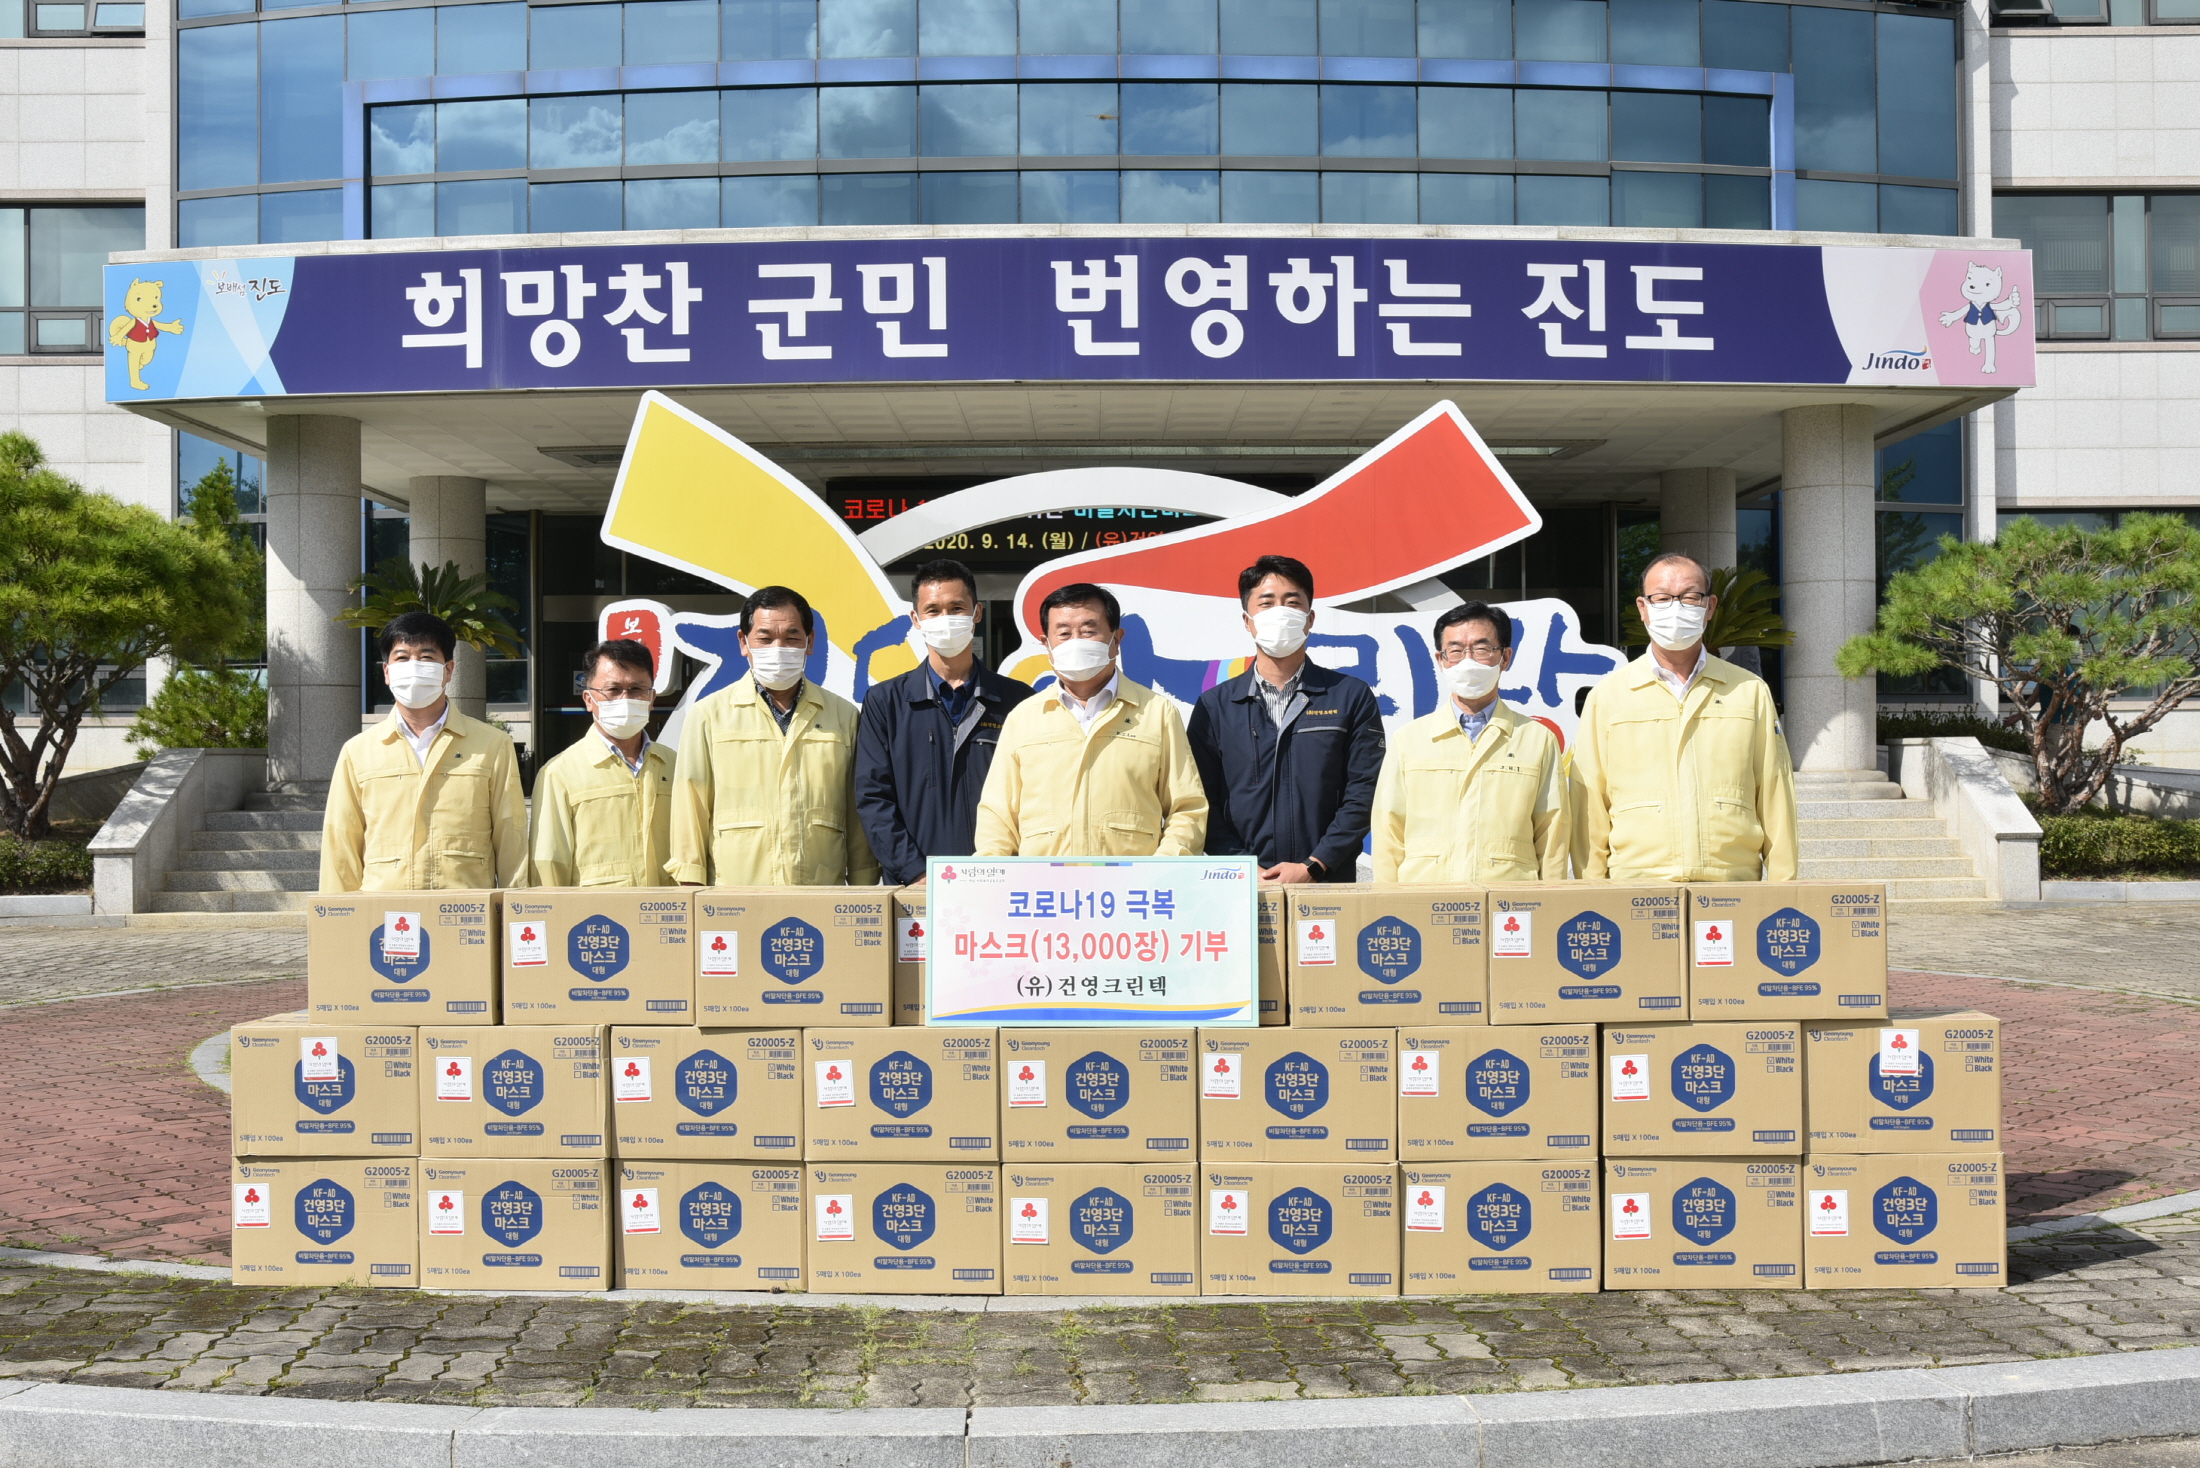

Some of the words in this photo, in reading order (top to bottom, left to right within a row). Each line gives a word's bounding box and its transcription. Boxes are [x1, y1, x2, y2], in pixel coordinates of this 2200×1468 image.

[216, 282, 246, 296] 보배섬
[248, 277, 286, 301] 진도
[402, 261, 702, 368] 희망찬
[747, 256, 949, 361] 군민
[1050, 254, 1472, 359] 번영하는
[1521, 259, 1715, 359] 진도
[1862, 352, 1920, 370] Jindo
[982, 533, 999, 549] 9.
[1006, 533, 1034, 549] 14.
[1042, 531, 1074, 549] (월)
[1200, 868, 1238, 881] Jindo
[1008, 889, 1116, 920] 코로나19
[1126, 889, 1176, 920] 극복
[1631, 896, 1680, 907] G20005-Z
[1831, 894, 1879, 904] G20005-Z
[440, 903, 485, 913] G20005-Z
[640, 902, 687, 911] G20005-Z
[834, 904, 882, 913] G20005-Z
[1432, 902, 1481, 912] G20005-Z
[587, 924, 610, 933] KF-AD
[1577, 921, 1601, 930] KF-AD
[1776, 918, 1800, 927] KF-AD
[780, 927, 804, 936] KF-AD
[1377, 926, 1401, 935] KF-AD
[1766, 929, 1811, 944] 건영3단
[577, 936, 620, 950] 건영3단
[771, 938, 814, 952] 건영3단
[1367, 937, 1411, 952] 건영3단
[1567, 932, 1611, 947] 건영3단
[955, 930, 1169, 963] 마스크(13,000장)
[1181, 930, 1229, 962] 기부
[1771, 945, 1808, 959] 마스크
[581, 951, 617, 964] 마스크
[775, 954, 811, 967] 마스크
[1371, 953, 1408, 967] 마스크
[1571, 948, 1608, 962] 마스크
[1782, 960, 1796, 969] 대형
[365, 1036, 411, 1045] G20005-Z
[553, 1036, 601, 1046] G20005-Z
[1540, 1035, 1589, 1045] G20005-Z
[1746, 1030, 1794, 1040] G20005-Z
[1945, 1030, 1994, 1039] G20005-Z
[748, 1038, 795, 1047] G20005-Z
[943, 1038, 991, 1047] G20005-Z
[1140, 1039, 1188, 1048] G20005-Z
[1340, 1039, 1388, 1049] G20005-Z
[501, 1059, 524, 1069] KF-AD
[695, 1060, 718, 1069] KF-AD
[1485, 1059, 1510, 1068] KF-AD
[1691, 1054, 1715, 1063] KF-AD
[889, 1061, 913, 1070] KF-AD
[1085, 1062, 1109, 1071] KF-AD
[1285, 1062, 1309, 1071] KF-AD
[1681, 1065, 1725, 1079] 건영3단
[492, 1071, 534, 1085] 건영3단
[685, 1071, 728, 1085] 건영3단
[879, 1072, 923, 1086] 건영3단
[1075, 1073, 1120, 1087] 건영3단
[1275, 1074, 1319, 1087] 건영3단
[1475, 1071, 1520, 1085] 건영3단
[308, 1084, 343, 1097] 마스크
[496, 1086, 531, 1099] 마스크
[689, 1086, 725, 1099] 마스크
[1685, 1081, 1722, 1095] 마스크
[1884, 1079, 1921, 1093] 마스크
[883, 1088, 920, 1101] 마스크
[1080, 1088, 1116, 1102] 마스크
[1279, 1089, 1316, 1102] 마스크
[1480, 1086, 1517, 1100] 마스크
[1091, 1104, 1105, 1112] 대형
[365, 1167, 410, 1176] G20005-Z
[552, 1168, 599, 1177] G20005-Z
[752, 1170, 799, 1179] G20005-Z
[1542, 1169, 1590, 1179] G20005-Z
[1747, 1164, 1795, 1174] G20005-Z
[1948, 1163, 1997, 1173] G20005-Z
[946, 1170, 994, 1180] G20005-Z
[1144, 1174, 1192, 1184] G20005-Z
[1343, 1175, 1392, 1184] G20005-Z
[313, 1188, 336, 1197] KF-AD
[500, 1190, 523, 1199] KF-AD
[699, 1192, 722, 1200] KF-AD
[892, 1193, 915, 1202] KF-AD
[1487, 1193, 1511, 1202] KF-AD
[1692, 1187, 1716, 1197] KF-AD
[1776, 1190, 1795, 1198] White
[1893, 1186, 1917, 1196] KF-AD
[304, 1200, 345, 1213] 건영3단
[1089, 1197, 1113, 1206] KF-AD
[1288, 1197, 1312, 1206] KF-AD
[1682, 1199, 1726, 1213] 건영3단
[1883, 1198, 1928, 1212] 건영3단
[491, 1202, 533, 1215] 건영3단
[689, 1203, 732, 1216] 건영3단
[882, 1205, 926, 1218] 건영3단
[1080, 1208, 1124, 1222] 건영3단
[1477, 1204, 1521, 1219] 건영3단
[308, 1215, 342, 1228] 마스크
[1278, 1209, 1322, 1222] 건영3단
[1686, 1215, 1723, 1228] 마스크
[1887, 1213, 1924, 1227] 마스크
[495, 1217, 530, 1230] 마스크
[693, 1218, 729, 1231] 마스크
[886, 1220, 923, 1233] 마스크
[1481, 1220, 1518, 1233] 마스크
[506, 1232, 519, 1240] 대형
[1084, 1224, 1120, 1237] 마스크
[1282, 1224, 1319, 1237] 마스크
[1698, 1230, 1711, 1238] 대형
